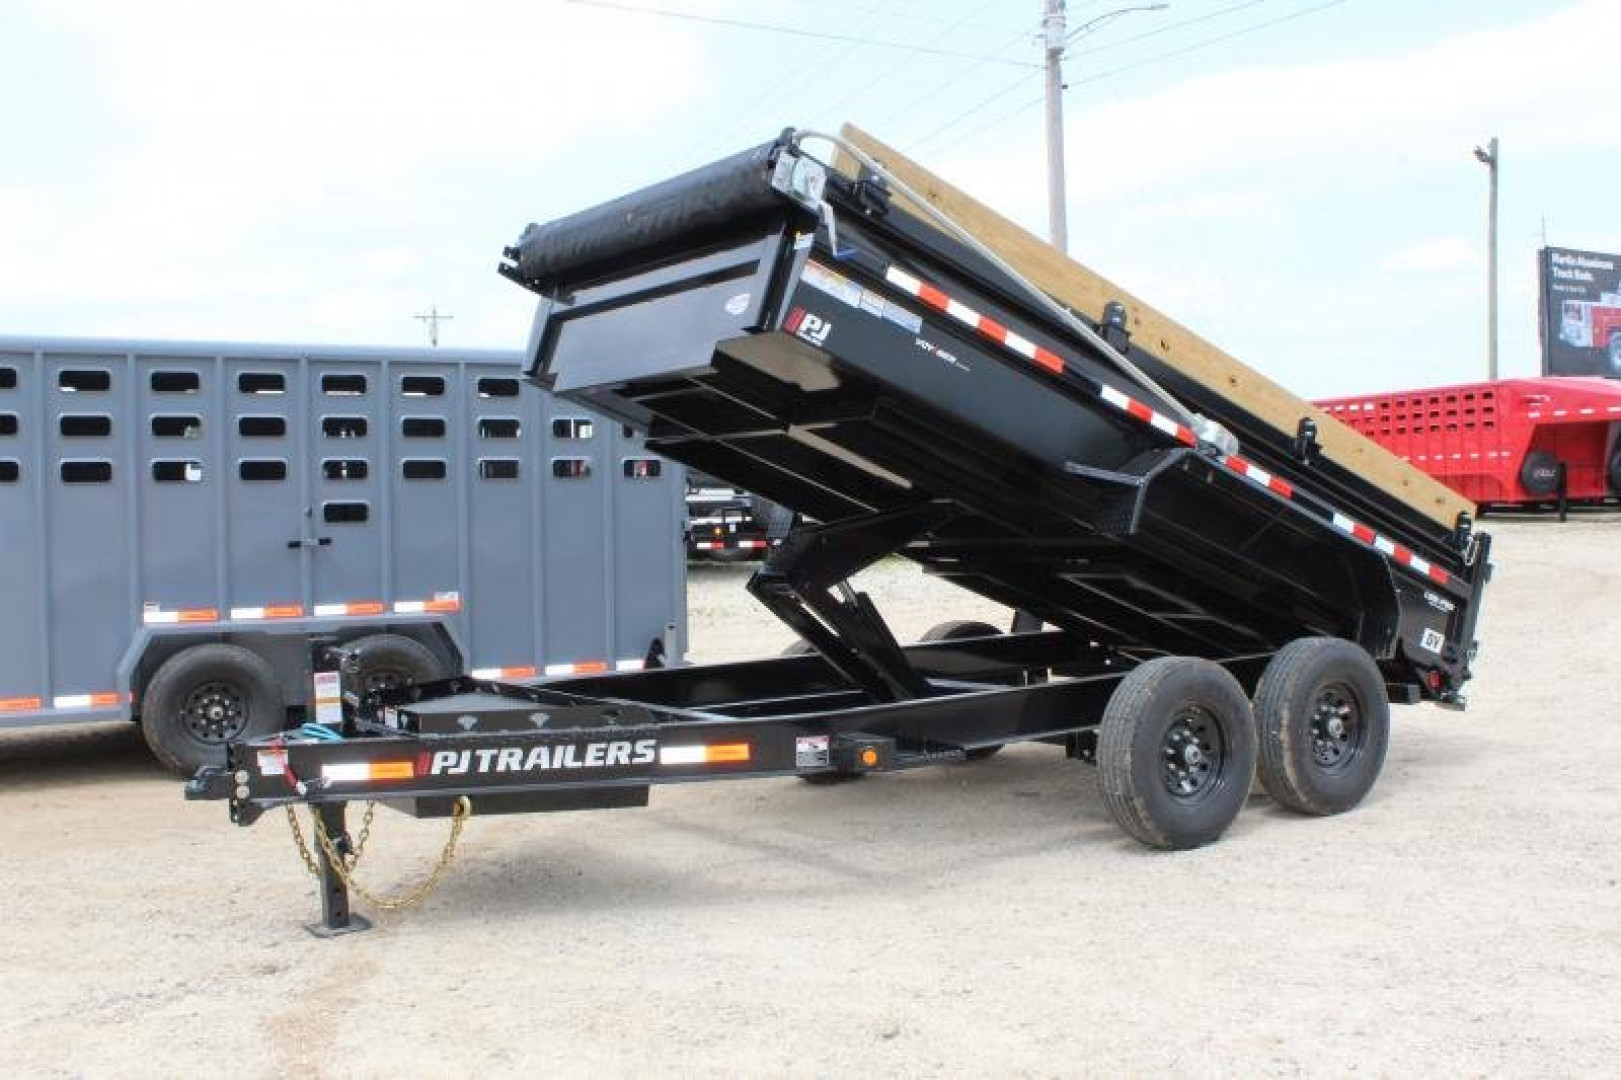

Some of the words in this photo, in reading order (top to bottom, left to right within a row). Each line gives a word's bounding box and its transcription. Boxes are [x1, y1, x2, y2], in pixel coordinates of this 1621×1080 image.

[796, 313, 832, 341] PJ
[430, 750, 471, 775] PJ
[474, 738, 658, 773] TRAILERS
